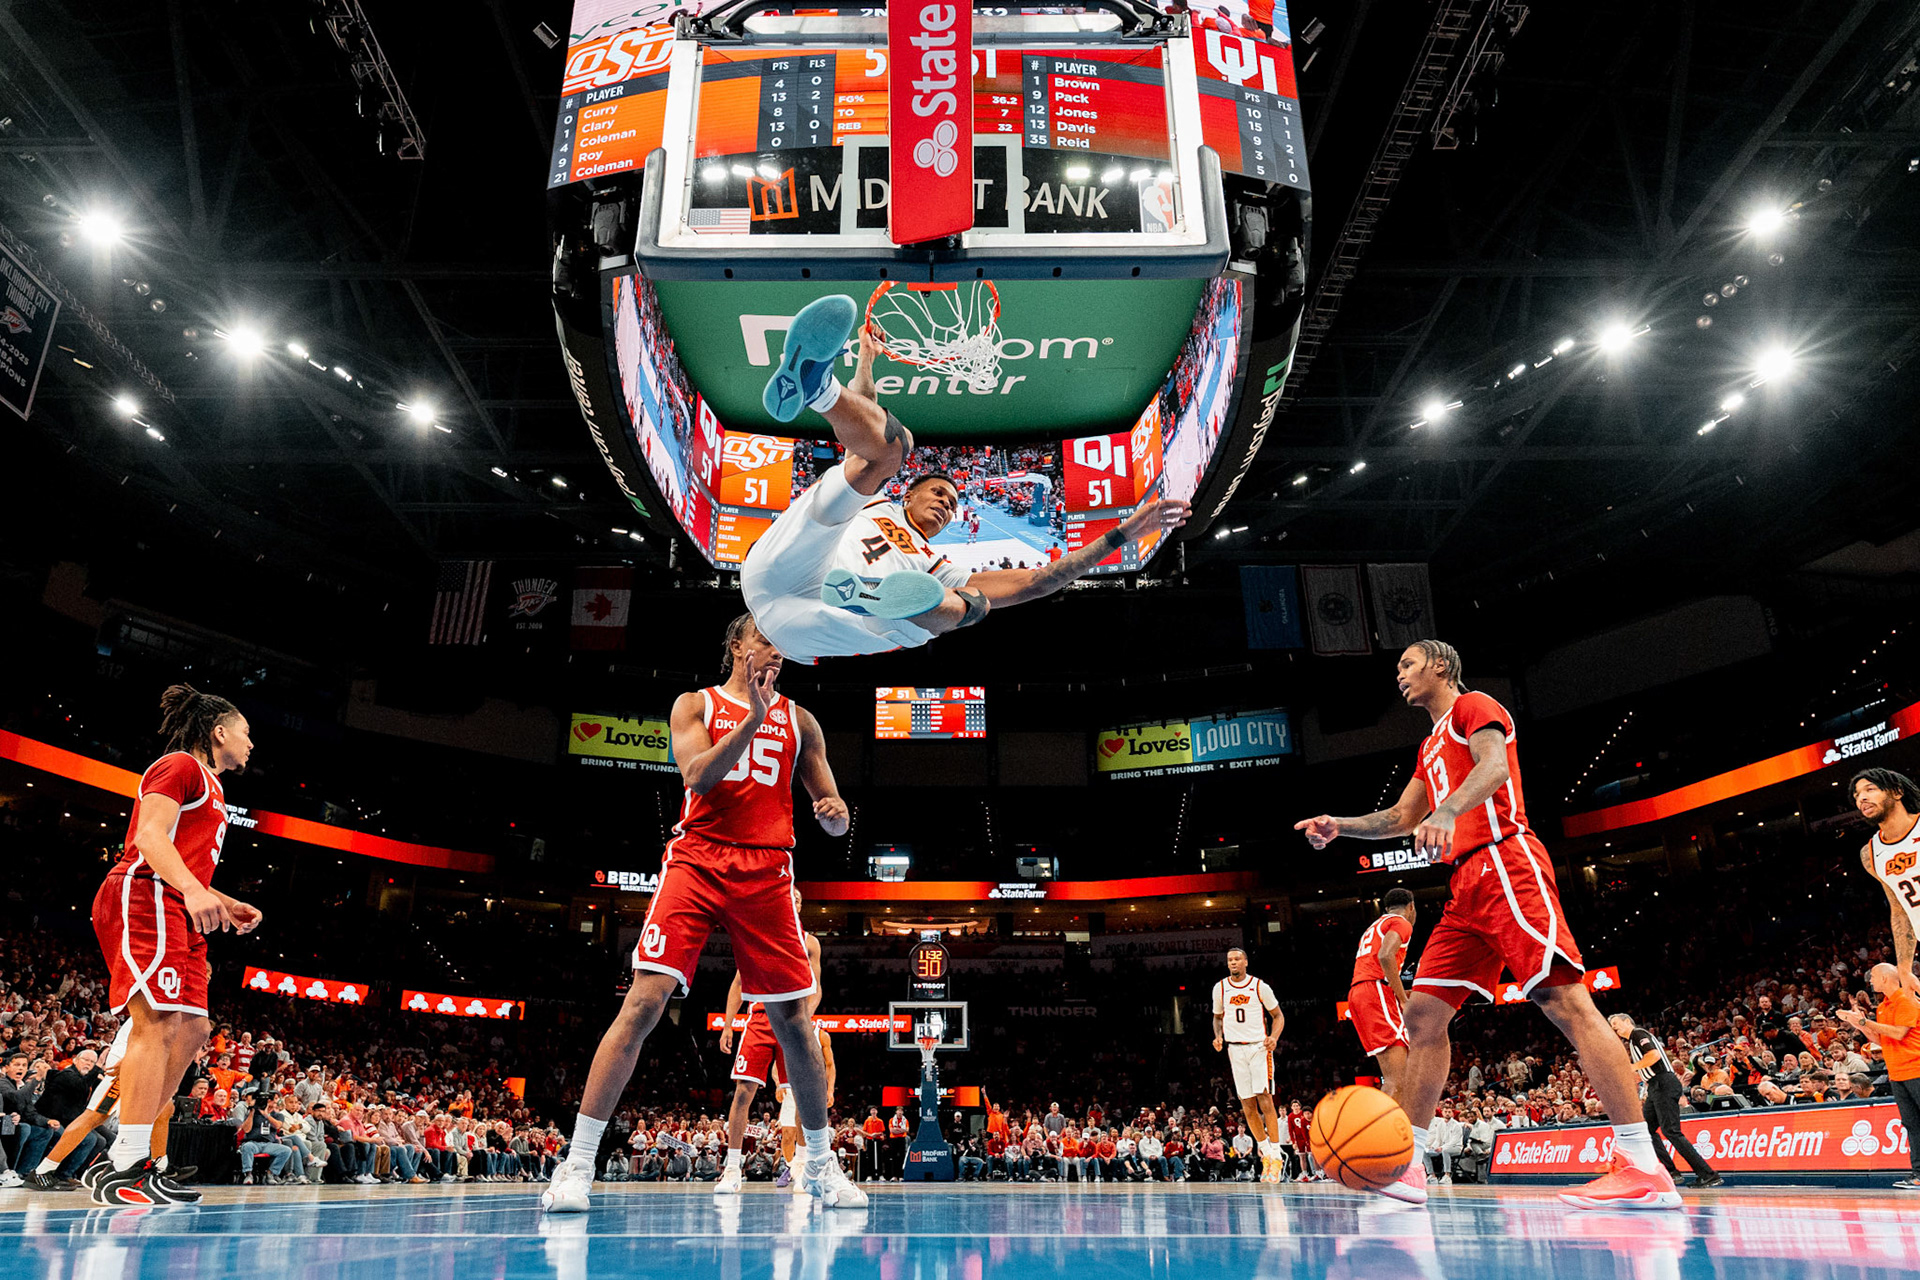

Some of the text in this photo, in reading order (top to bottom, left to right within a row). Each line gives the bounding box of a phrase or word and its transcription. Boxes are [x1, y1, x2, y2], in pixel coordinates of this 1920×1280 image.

[772, 59, 826, 71] PTS FLS
[908, 4, 957, 118] State
[1054, 62, 1097, 76] PLAYER
[774, 76, 822, 88] 4 0
[1033, 76, 1100, 91] 1 Brown
[586, 85, 624, 103] PLAYER
[771, 91, 821, 102] 13 2
[838, 95, 1018, 105] FG% 36.2
[1032, 90, 1089, 104] 9 Pack
[1244, 92, 1293, 112] PTS FLS
[563, 104, 618, 125] 0 Curry
[773, 105, 819, 117] 8 1
[838, 109, 1009, 117] TO 7
[1029, 105, 1098, 119] 12 Jones
[1246, 107, 1290, 125] 10 1
[563, 119, 615, 139] 1 Clary
[769, 120, 820, 131] 13 0
[837, 122, 1013, 132] REB 32
[1030, 119, 1096, 134] 13 Davis
[1248, 121, 1292, 140] 15 1
[559, 129, 637, 154] 4 Coleman
[771, 135, 818, 147] 0 1
[1029, 134, 1090, 148] 35 Reid
[1253, 136, 1295, 154] 9 2
[558, 150, 603, 168] 9 Roy
[1255, 150, 1295, 169] 3 1
[553, 158, 633, 183] 21 Coleman
[1257, 165, 1299, 184] 5 0
[6, 281, 37, 320] THUNDER
[701, 451, 713, 487] 51
[1143, 452, 1155, 488] 51
[744, 478, 768, 505] 51
[1088, 479, 1112, 507] 51
[721, 506, 739, 514] PLAYER
[872, 517, 920, 554] OSU
[860, 535, 892, 565] 4
[511, 578, 558, 595] THUNDER
[897, 690, 910, 698] 51
[952, 689, 965, 698] 51
[1195, 720, 1287, 757] LOUD CITY
[1834, 721, 1887, 746] PRESENTED BY
[581, 758, 681, 774] BRING THE THUNDE
[1110, 757, 1280, 780] BRING THE THUNDER EXIT NOW
[1426, 756, 1450, 808] 13
[210, 820, 227, 865] 9
[1885, 851, 1917, 876] OSU
[607, 871, 659, 887] BEDLA
[641, 923, 667, 958] OU
[919, 950, 942, 960] 11:32
[918, 960, 941, 977] 30
[158, 967, 181, 999] OU
[1007, 1006, 1098, 1017] THUNDER
[1236, 1008, 1245, 1023] 0
